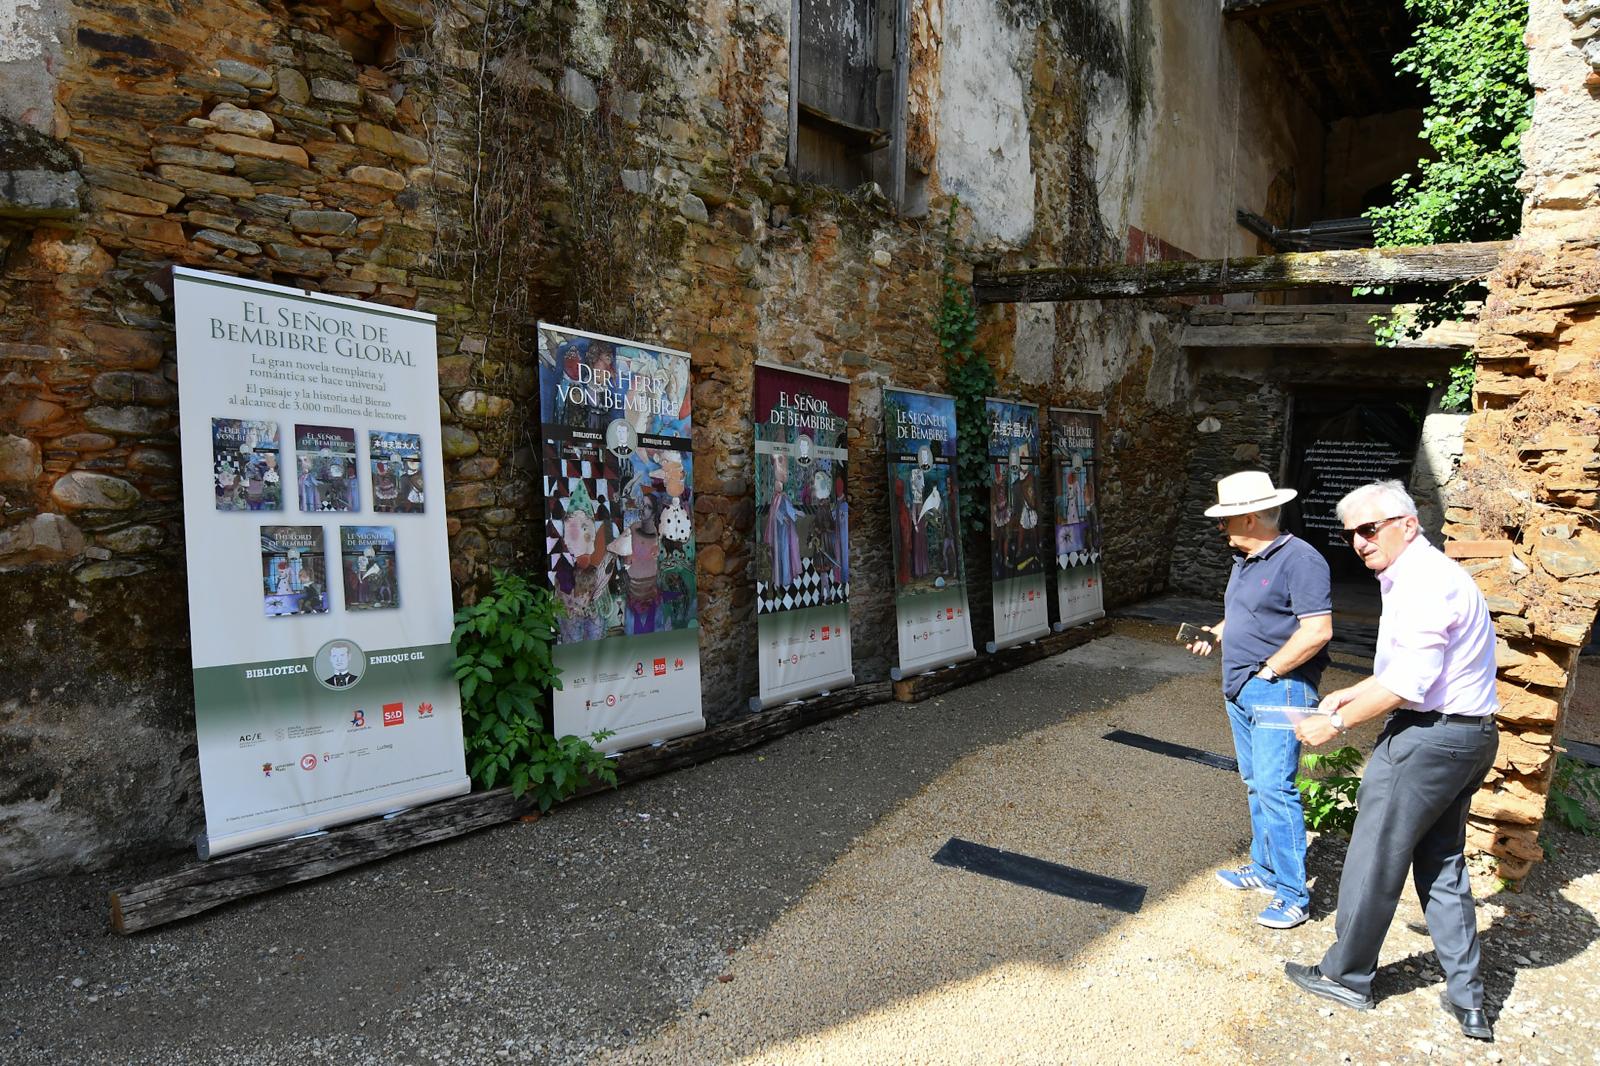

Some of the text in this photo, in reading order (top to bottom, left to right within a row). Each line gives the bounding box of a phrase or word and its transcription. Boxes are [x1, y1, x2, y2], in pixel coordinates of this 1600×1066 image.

[243, 301, 389, 344] EL SEÑOR DE
[209, 317, 417, 368] BEMBIBRE GLOBAL
[252, 353, 384, 383] La gran novela templaria y
[577, 363, 666, 395] DER HERR
[249, 369, 386, 392] romántica se hace universal
[246, 383, 391, 408] El paisaje y la historia del Bierzo
[556, 384, 680, 417] VON BEMBIBRE
[780, 391, 829, 414] EL SEÑOR
[228, 394, 407, 421] al alcance de 3.000 millones de lectores
[896, 409, 907, 424] LE
[770, 409, 836, 432] DE BEMBIBRE
[572, 430, 603, 440] BIBLIOTECA
[897, 425, 948, 442] DE BEMBIBRE
[369, 651, 426, 666] ENRIQUE GIL
[245, 663, 309, 680] BIBLIOTECA
[384, 711, 403, 720] S&D
